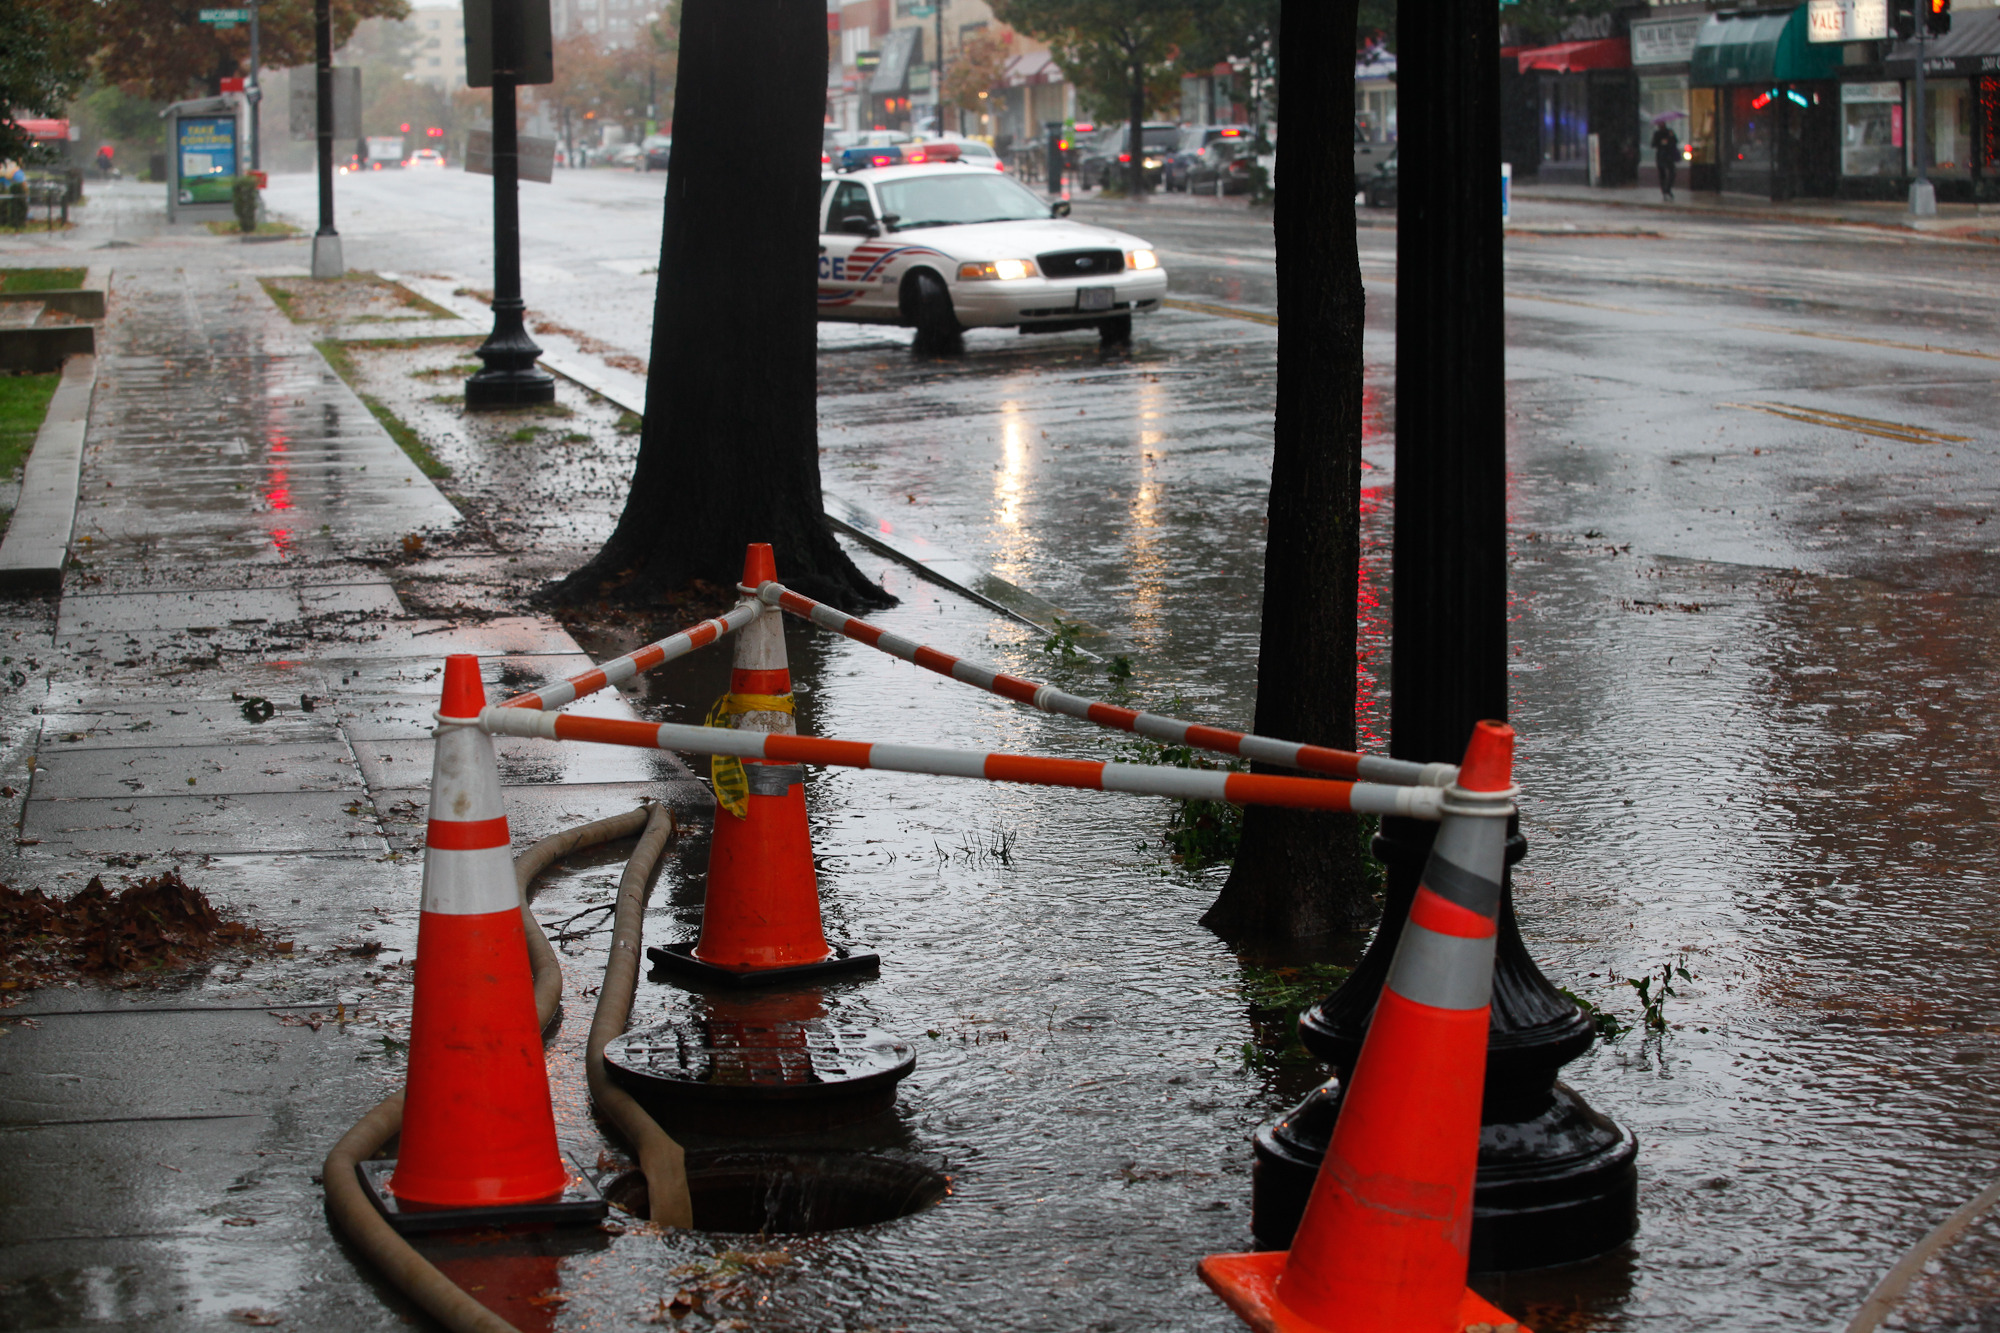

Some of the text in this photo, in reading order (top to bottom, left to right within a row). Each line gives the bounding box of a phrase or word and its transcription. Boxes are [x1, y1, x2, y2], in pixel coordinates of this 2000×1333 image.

[1810, 9, 1847, 30] VALET
[187, 125, 215, 135] TAKE
[180, 134, 232, 146] CONTROL
